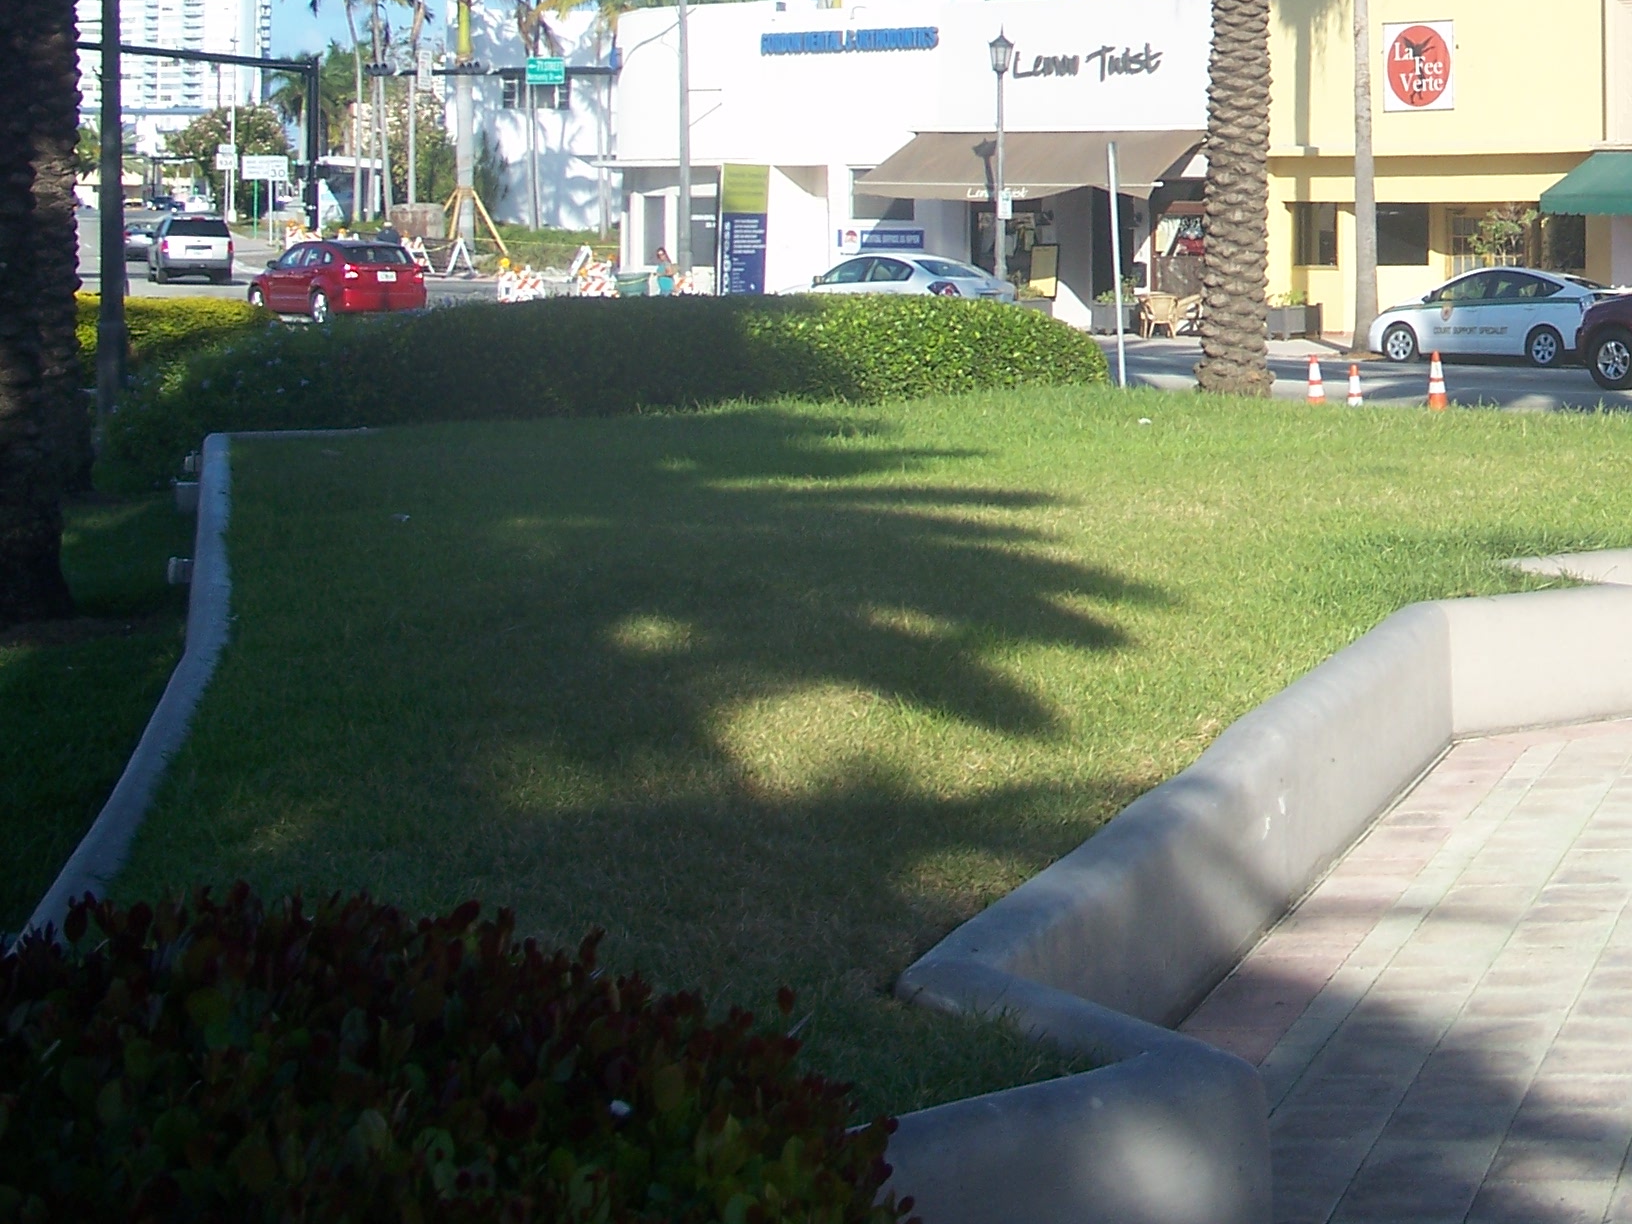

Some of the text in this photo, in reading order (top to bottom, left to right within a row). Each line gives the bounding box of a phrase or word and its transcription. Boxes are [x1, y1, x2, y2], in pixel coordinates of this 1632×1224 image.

[1394, 42, 1414, 61] La
[1013, 42, 1163, 82] Lemon Twist
[1414, 56, 1444, 75] Fee
[1399, 73, 1444, 92] Verte
